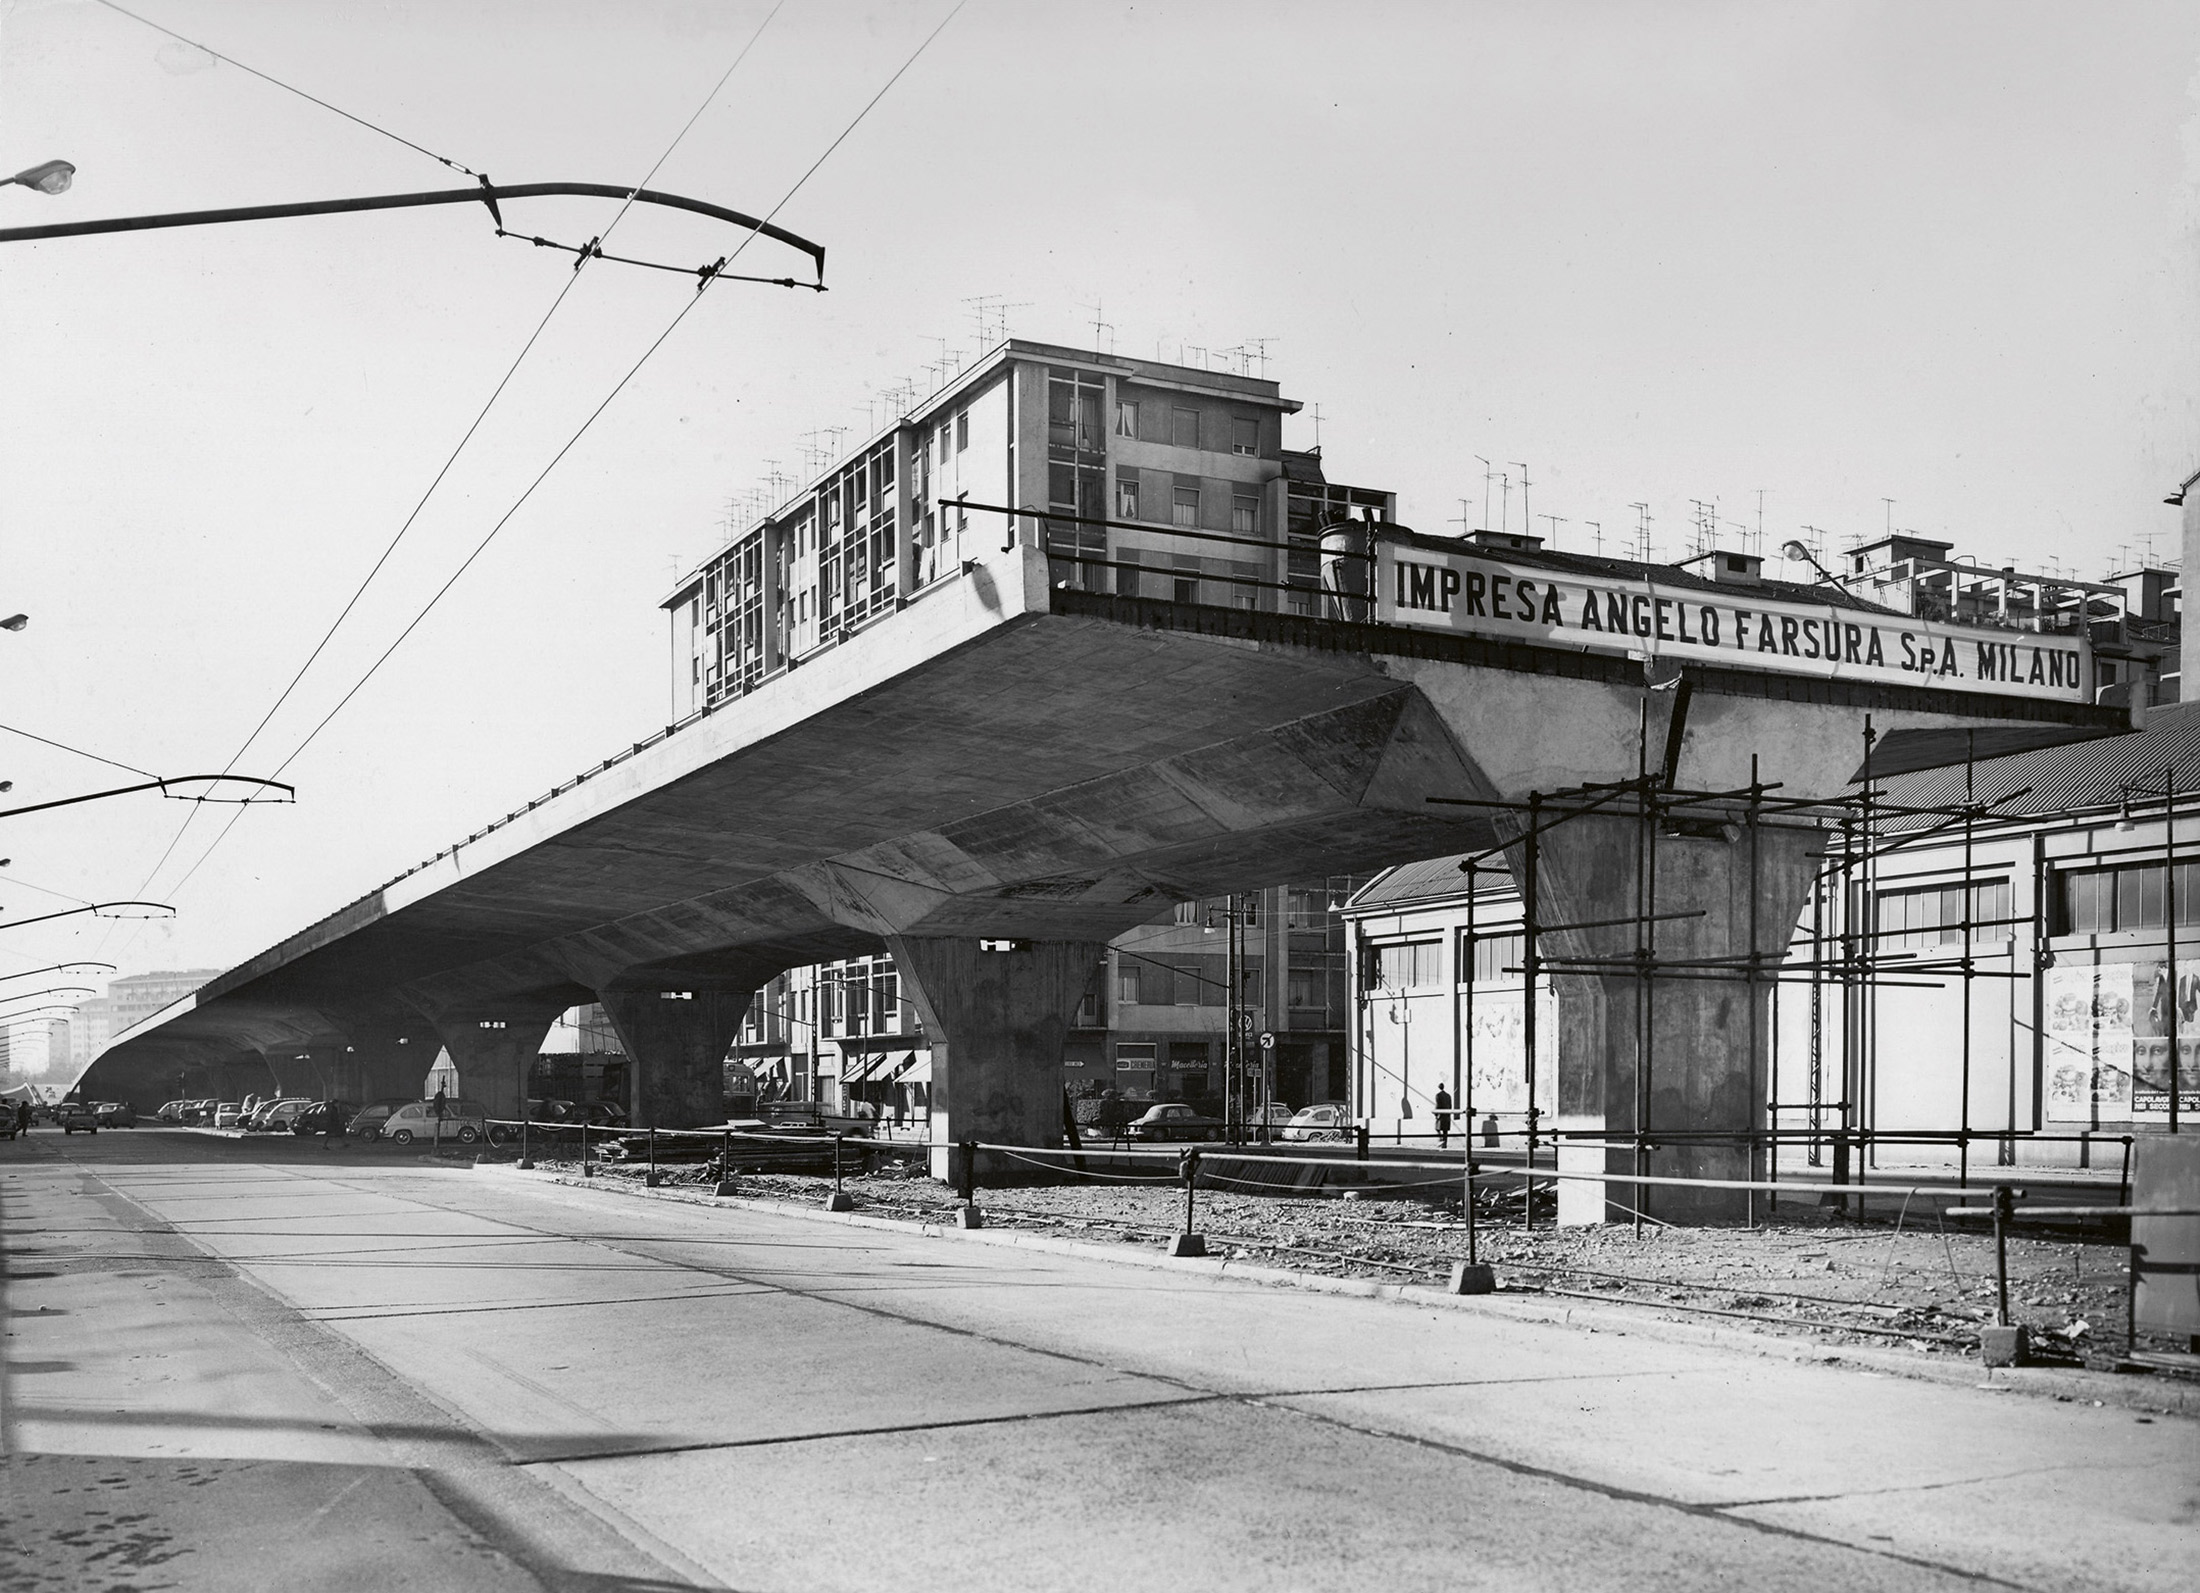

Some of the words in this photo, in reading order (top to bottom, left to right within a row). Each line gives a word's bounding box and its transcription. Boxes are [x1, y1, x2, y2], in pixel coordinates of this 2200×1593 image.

[1399, 560, 1564, 628] IMPRESA
[1581, 588, 1720, 647] ANGELO
[1735, 610, 1884, 667] FARSURA
[1977, 641, 2081, 689] MILANO
[1171, 1059, 1208, 1070] Macelleria
[2134, 1095, 2170, 1103] CAPOLAVOR
